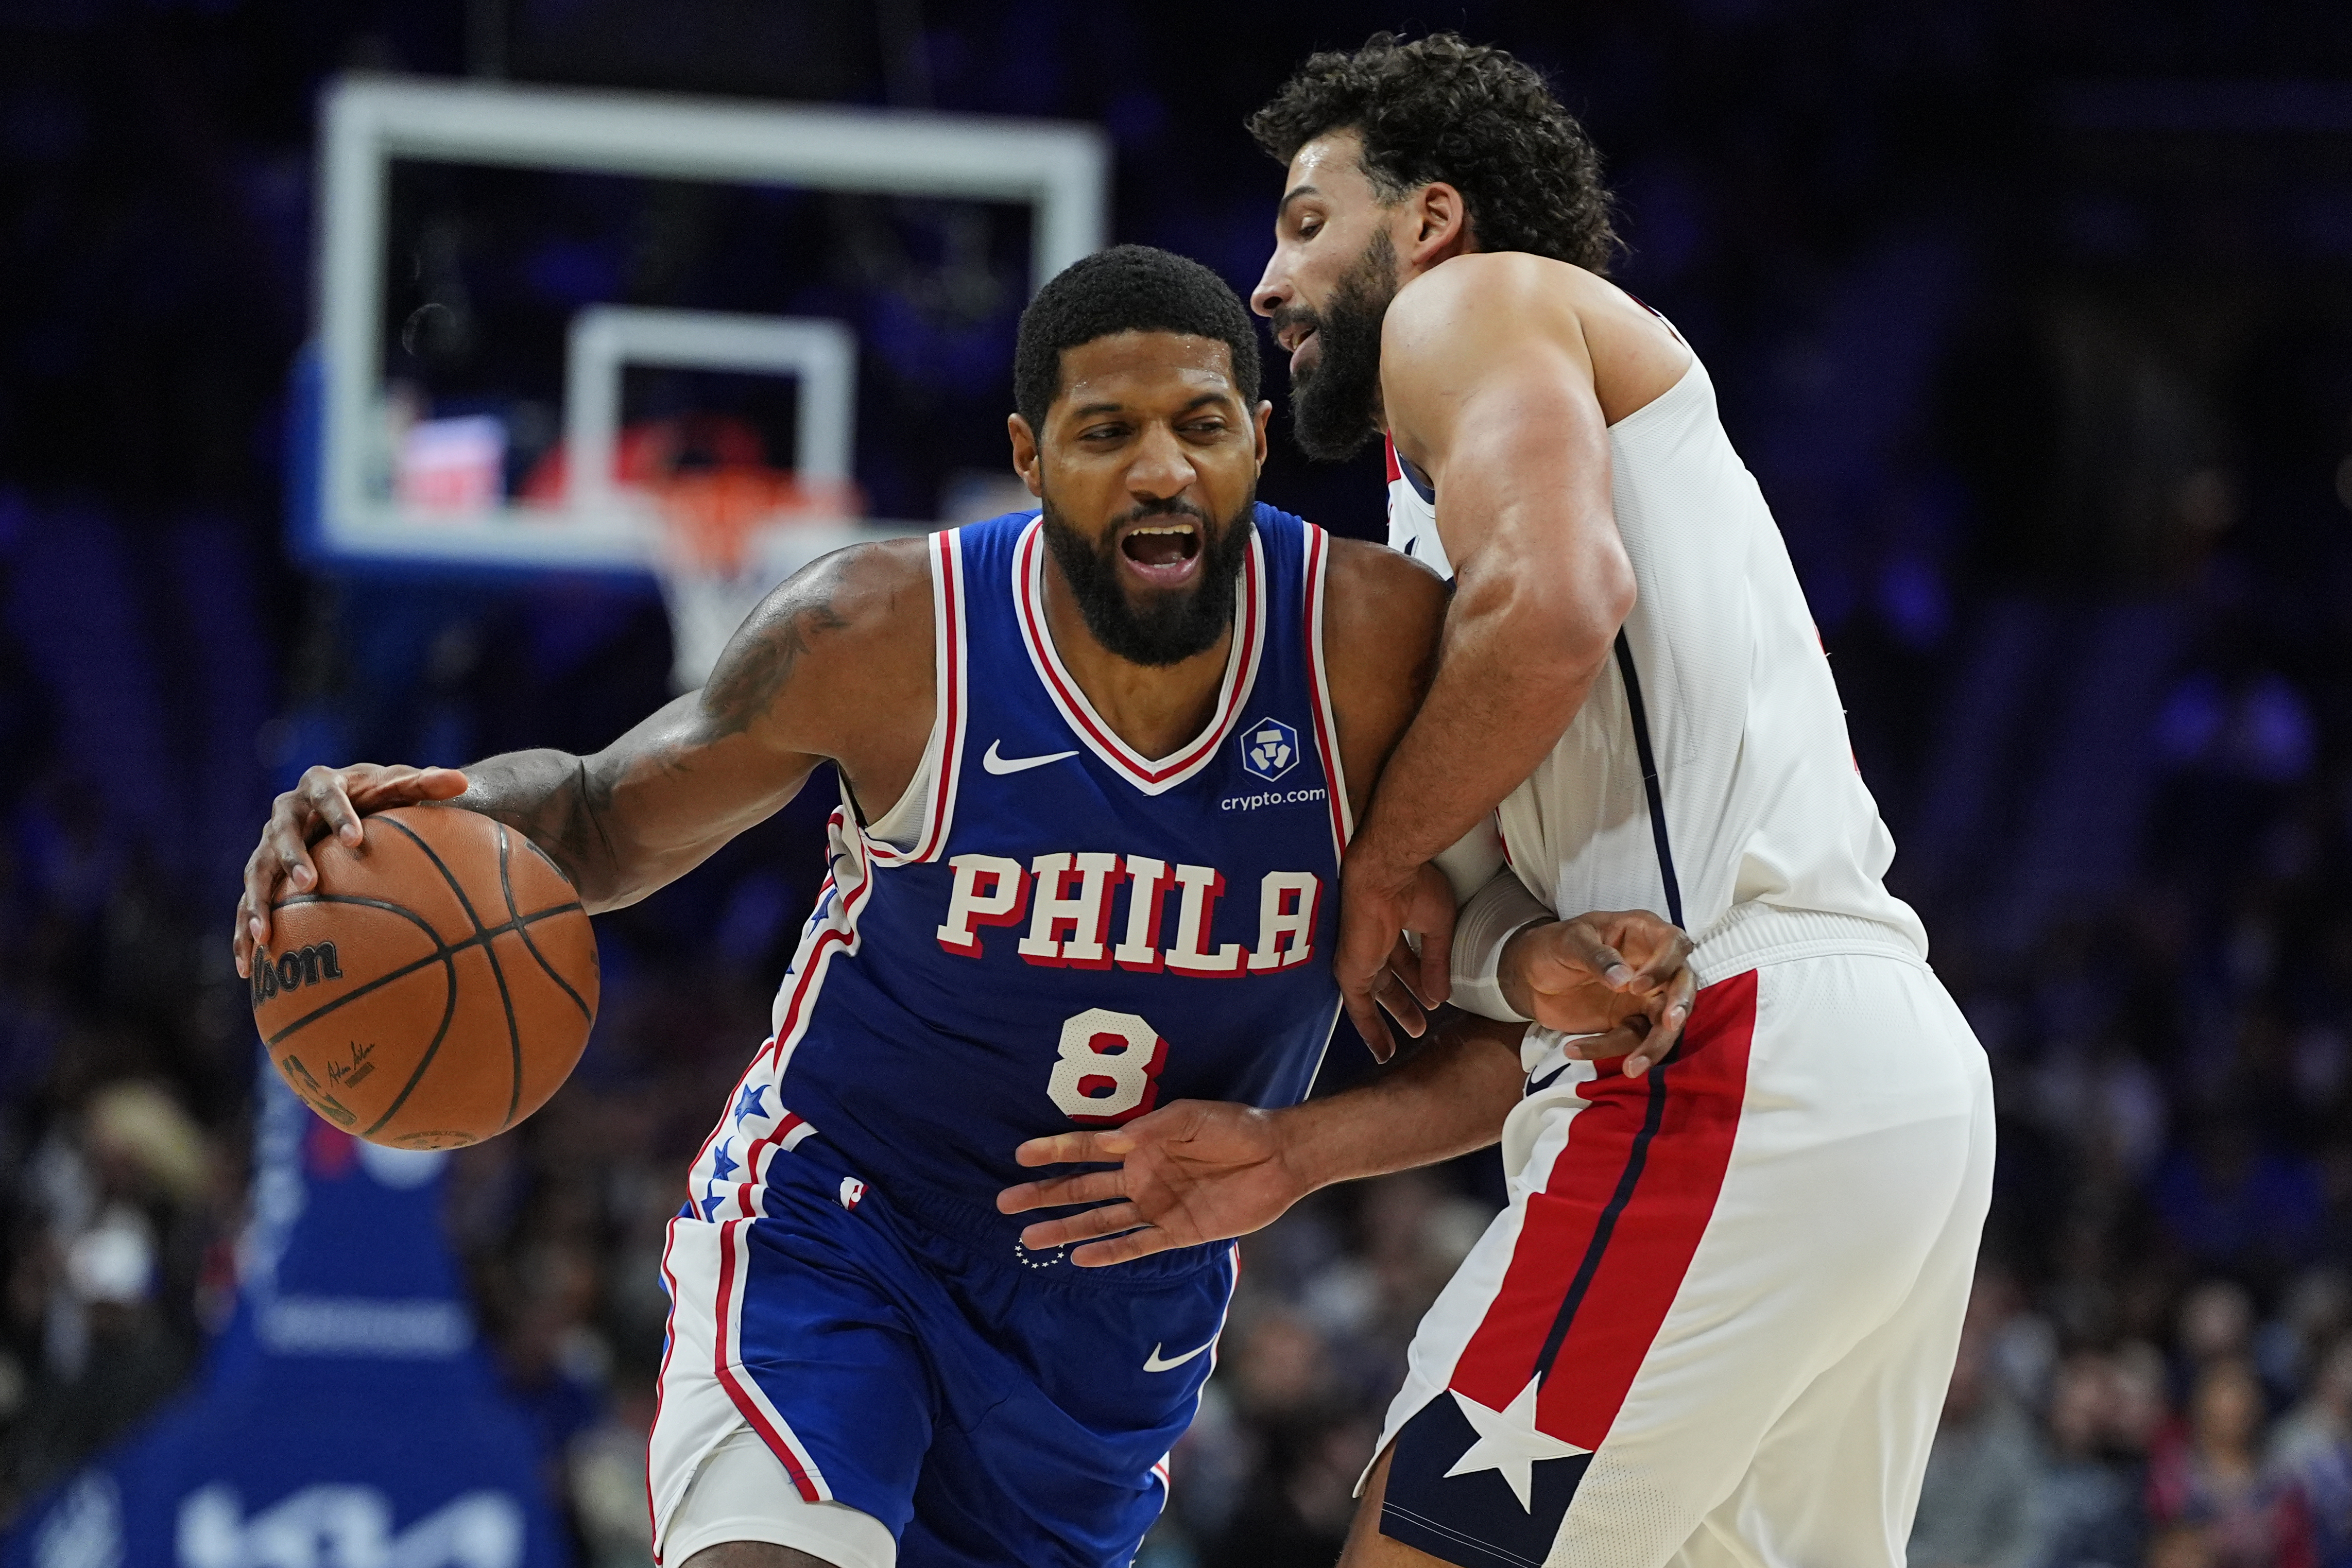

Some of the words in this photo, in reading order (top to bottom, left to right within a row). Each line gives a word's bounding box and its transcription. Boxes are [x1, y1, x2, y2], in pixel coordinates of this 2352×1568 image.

[1221, 788, 1326, 811] crypto.com
[936, 852, 1324, 977] PHILA
[1046, 1008, 1170, 1124] 8
